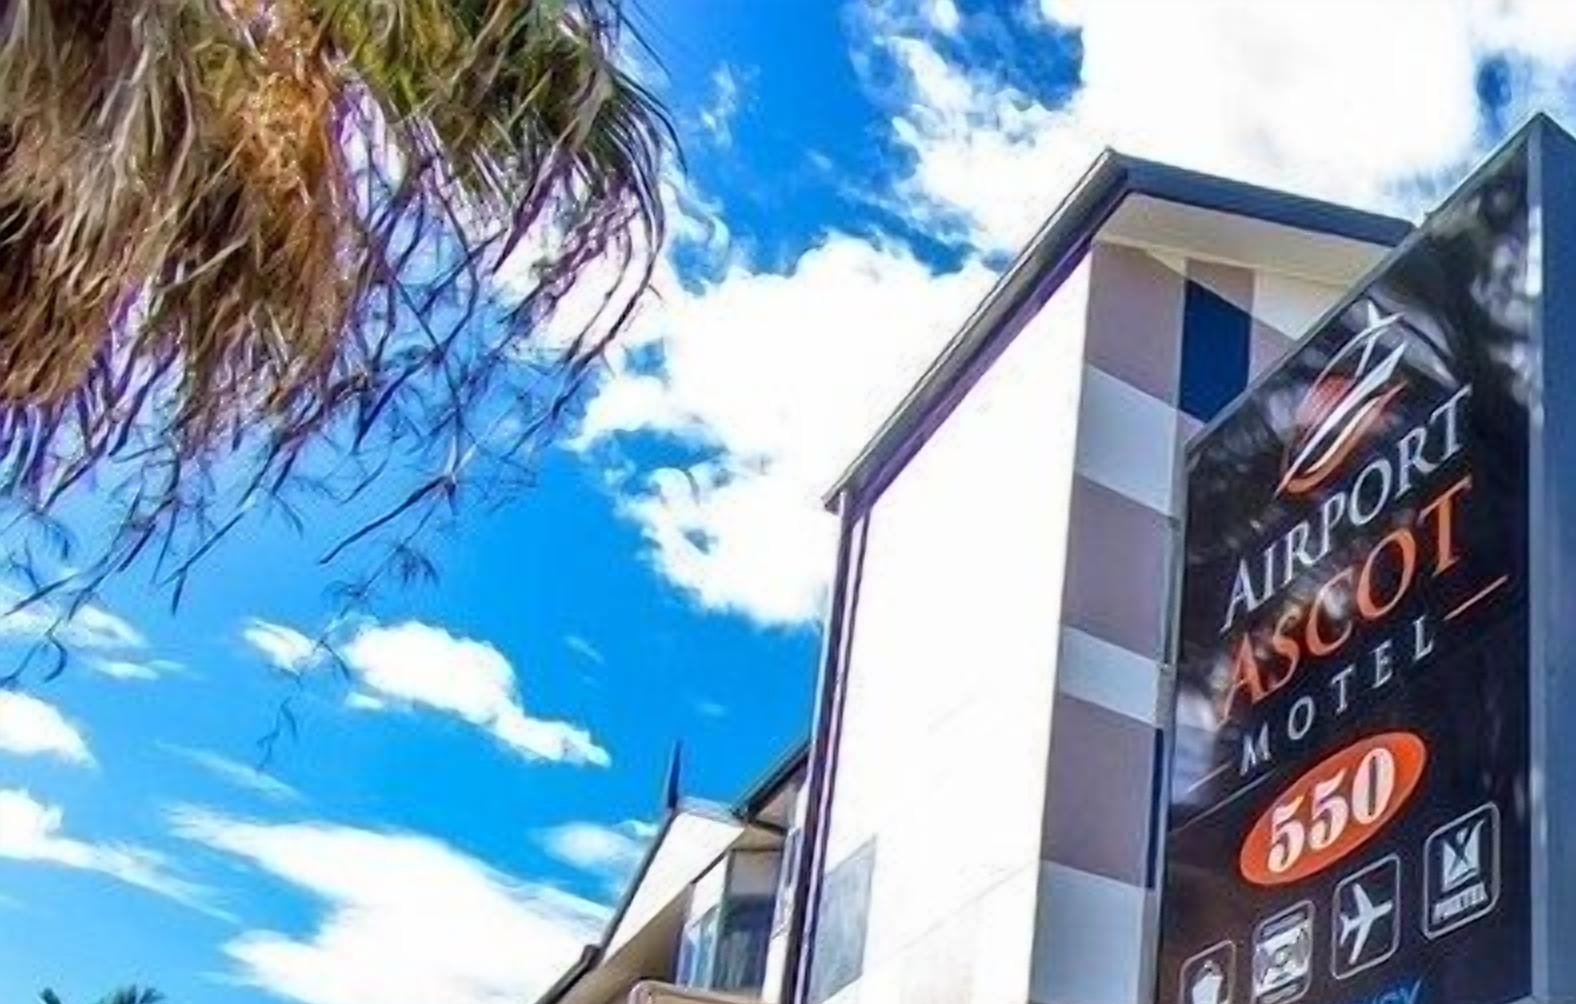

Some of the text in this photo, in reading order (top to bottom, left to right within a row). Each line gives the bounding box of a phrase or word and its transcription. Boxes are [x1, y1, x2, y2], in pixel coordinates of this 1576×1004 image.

[1219, 383, 1473, 634] AIRPORT
[1221, 474, 1473, 723] ASCOT
[1239, 614, 1436, 778] MOTEL
[1266, 747, 1396, 874] 550
